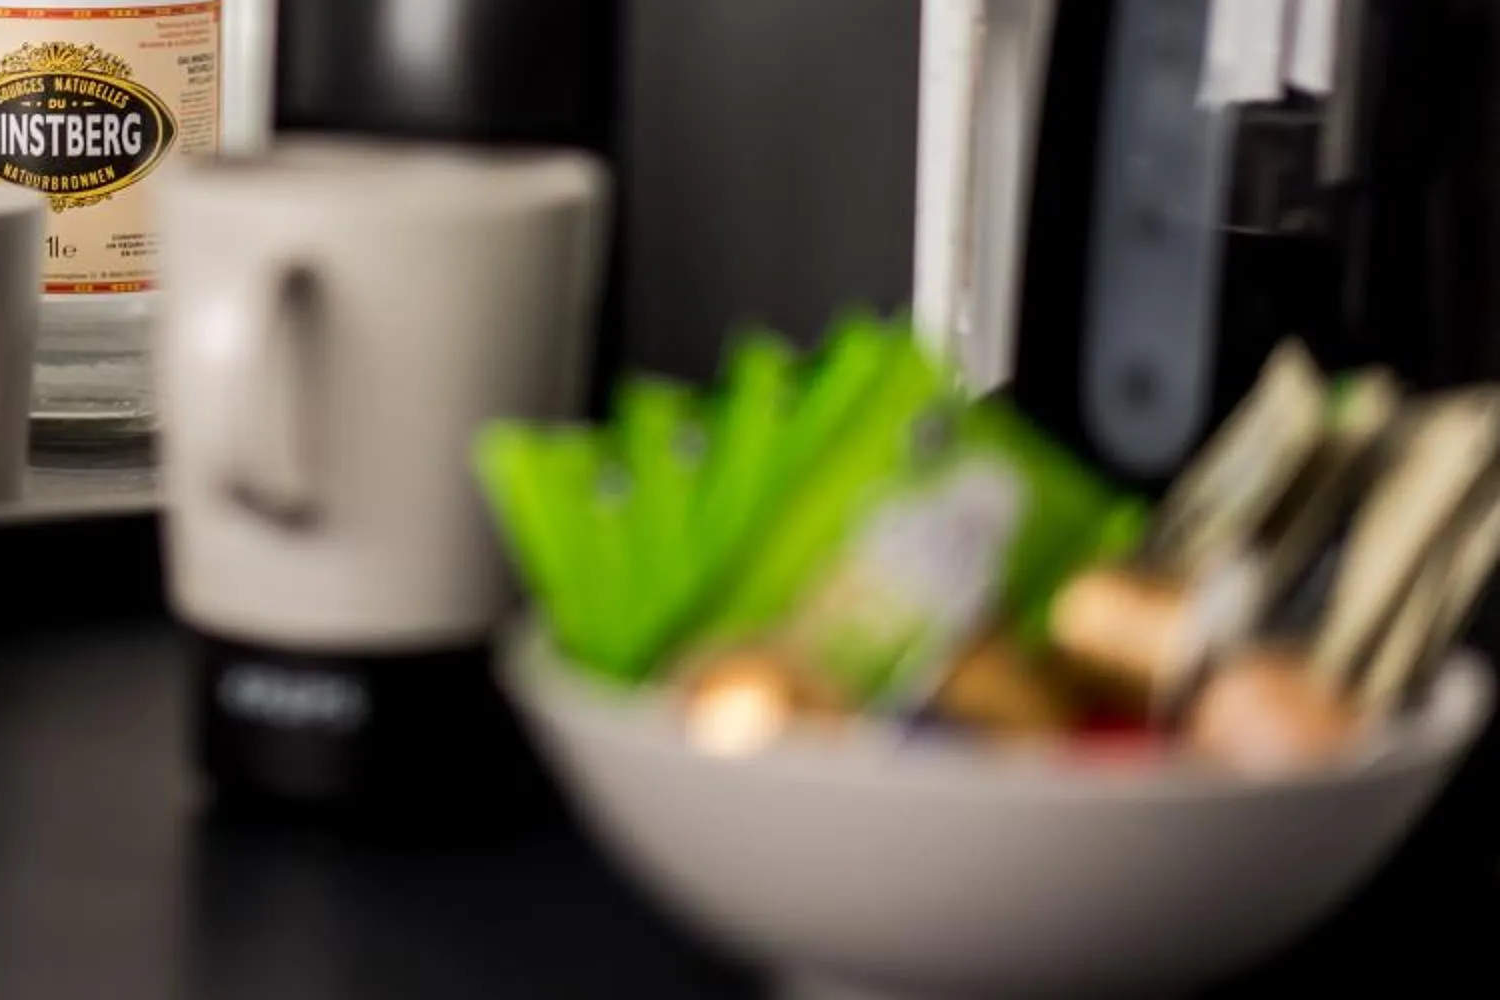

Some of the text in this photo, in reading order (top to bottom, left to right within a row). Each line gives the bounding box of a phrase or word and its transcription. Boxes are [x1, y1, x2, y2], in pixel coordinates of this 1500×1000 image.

[47, 98, 67, 109] DU
[54, 77, 130, 109] NATURELLES
[3, 161, 116, 191] NATUURBRONNEN
